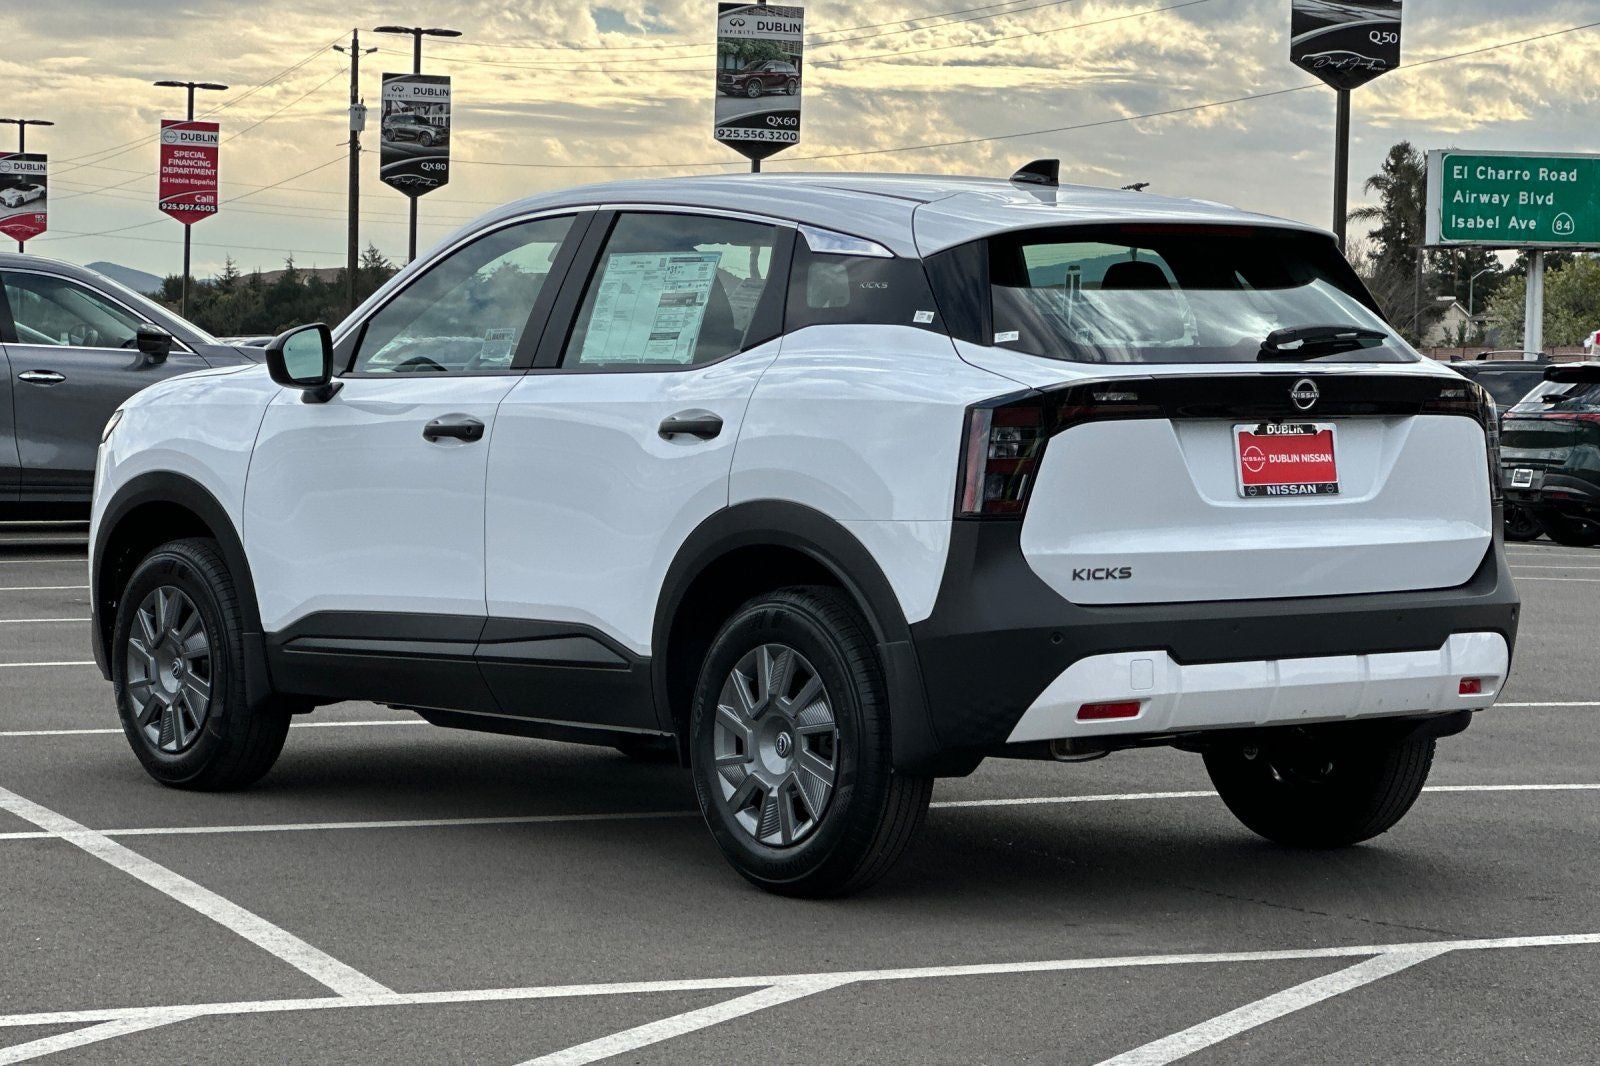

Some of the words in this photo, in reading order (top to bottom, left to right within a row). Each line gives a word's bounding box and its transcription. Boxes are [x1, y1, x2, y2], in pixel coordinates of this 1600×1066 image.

[757, 21, 801, 33] DUBLIN
[1369, 30, 1398, 45] Q50
[413, 87, 449, 97] DUBLIN
[766, 116, 798, 126] QX60
[180, 133, 217, 143] DUBLIN
[717, 129, 797, 141] 925.556.3200
[174, 150, 206, 159] SPECIAL
[13, 163, 46, 171] DUBLIN
[168, 158, 211, 167] FINANCING
[420, 162, 447, 171] QX80
[162, 167, 216, 176] DEPARTMENT
[1453, 165, 1468, 179] El
[1476, 166, 1530, 181] Charro
[1539, 168, 1577, 182] Road
[195, 195, 214, 203] Call!
[1452, 190, 1510, 207] Airway
[1518, 191, 1554, 205] Blvd
[161, 203, 215, 212] 925.997.4505
[1451, 214, 1499, 229] Isabel
[1508, 216, 1537, 230] Ave
[1555, 220, 1571, 231] 84
[859, 281, 888, 289] KICKS
[1291, 391, 1320, 399] NISSAN
[1266, 425, 1303, 434] DUBLIN
[1269, 454, 1299, 463] DUBLIN
[1301, 453, 1333, 463] NISSAN
[1266, 484, 1317, 495] NISSAN
[1072, 566, 1132, 581] KICKS
